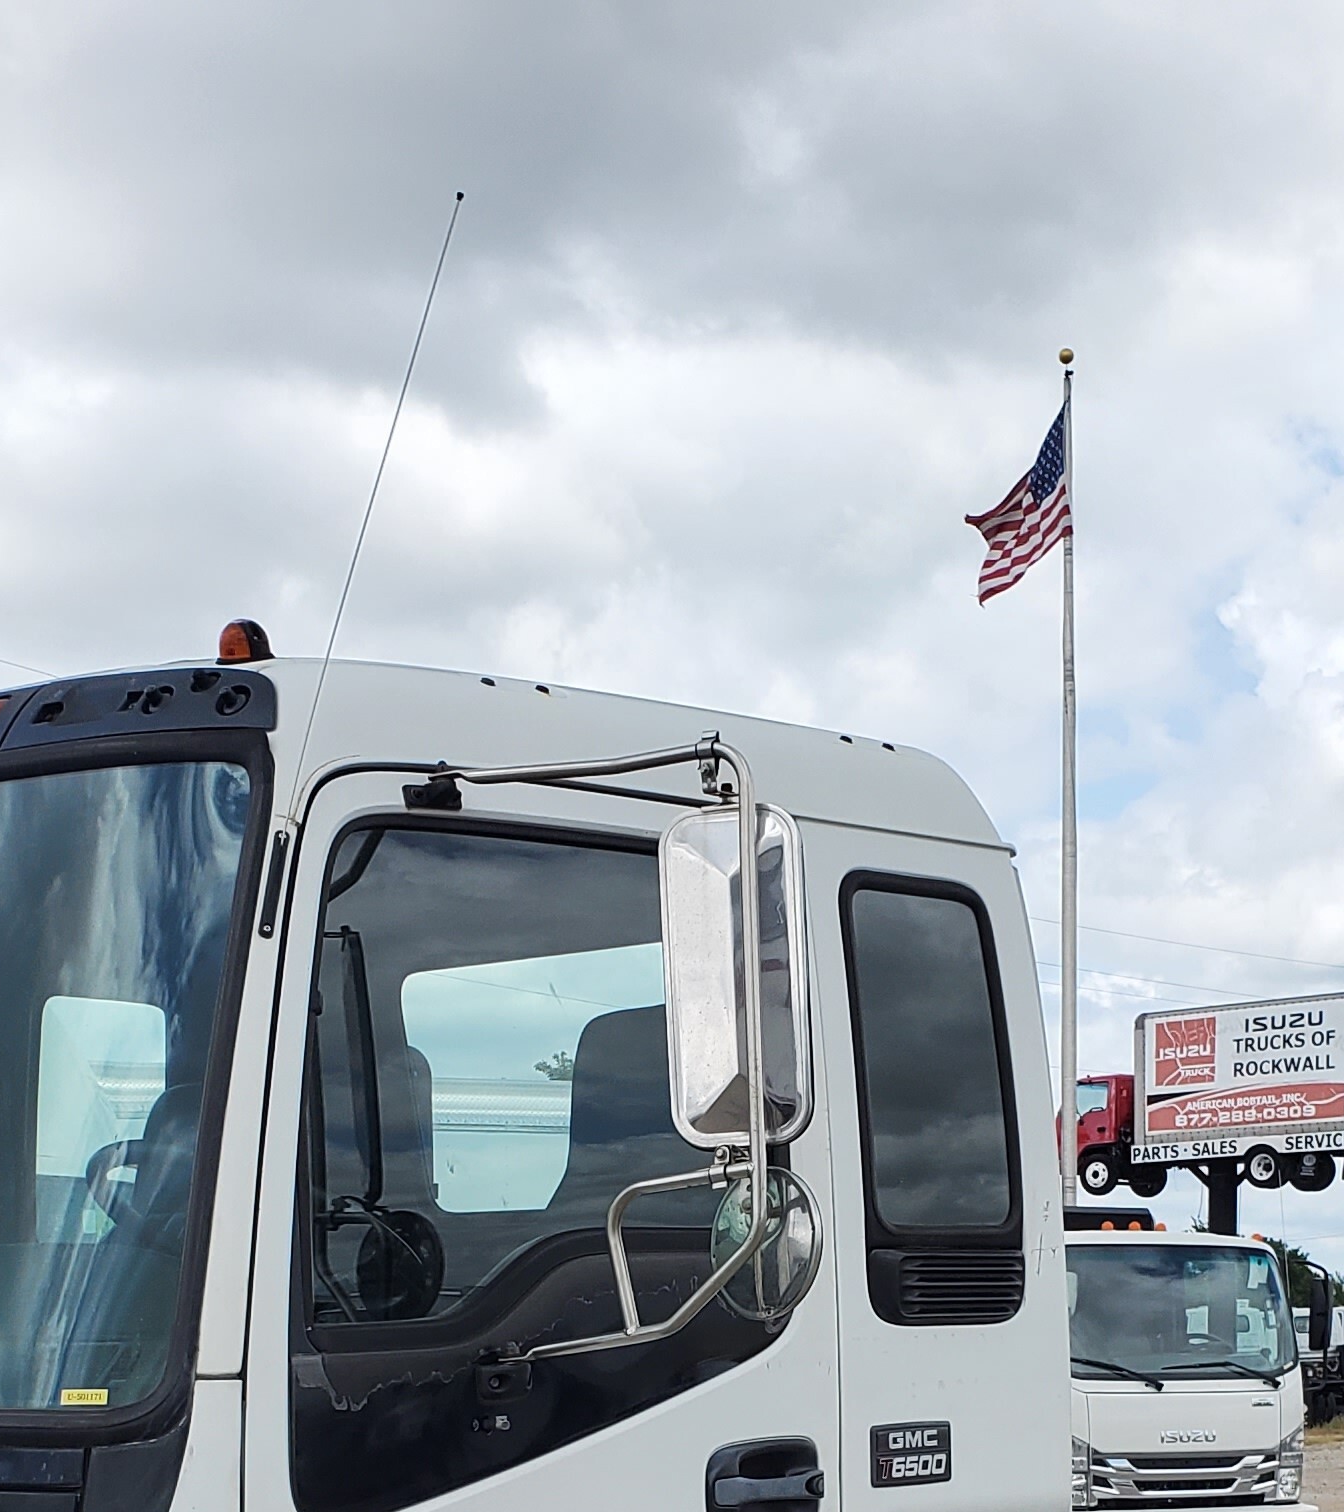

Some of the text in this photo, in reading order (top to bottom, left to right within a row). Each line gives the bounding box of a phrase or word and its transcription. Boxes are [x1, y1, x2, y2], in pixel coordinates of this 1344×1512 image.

[1245, 1011, 1323, 1032] ISUZU
[1159, 1044, 1211, 1059] ISUZU
[1233, 1030, 1336, 1053] TRUCKS OF
[1180, 1067, 1211, 1077] TRUCK
[1233, 1055, 1336, 1077] ROCKWALL
[1185, 1097, 1235, 1111] AMERICAN
[1132, 1145, 1179, 1161] PARTS
[1192, 1140, 1238, 1156] SALES
[888, 1429, 938, 1450] GMC
[1160, 1430, 1216, 1444] ISUZU
[879, 1453, 946, 1479] T6500
